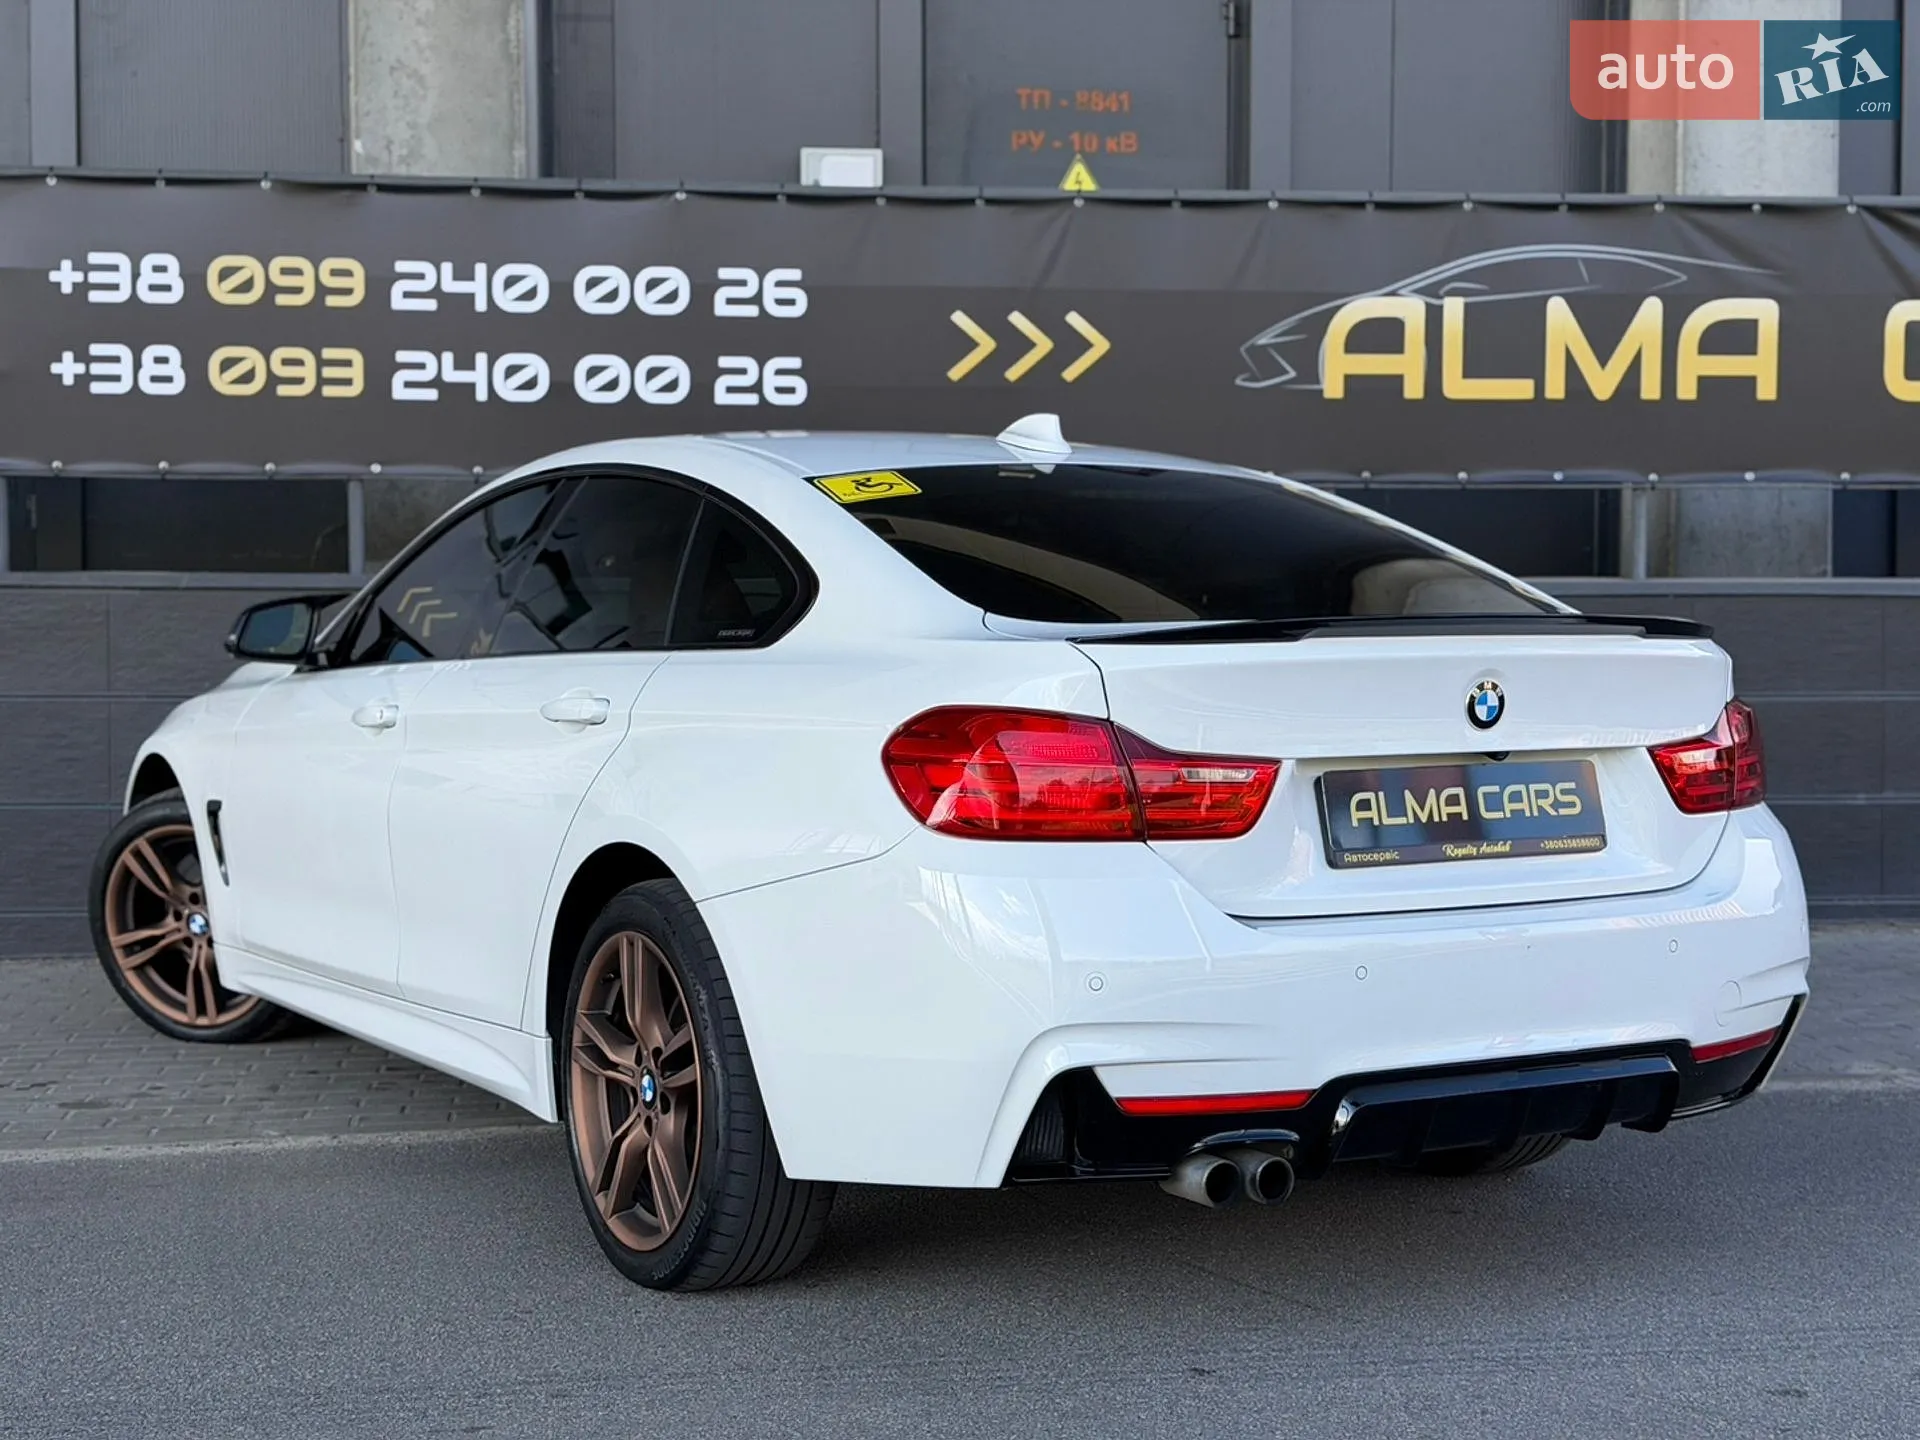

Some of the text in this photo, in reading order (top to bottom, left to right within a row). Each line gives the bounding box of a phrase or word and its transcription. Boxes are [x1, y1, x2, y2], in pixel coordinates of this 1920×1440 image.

[1017, 87, 1052, 110] ТП
[1011, 130, 1045, 153] РУ
[1070, 131, 1098, 154] 10
[1105, 131, 1139, 154] кВ
[48, 251, 808, 318] +38 099 240 00 26
[49, 342, 808, 406] +38 093 240 00 26
[1322, 296, 1780, 401] ALMA
[1350, 782, 1582, 828] ALMA CARS
